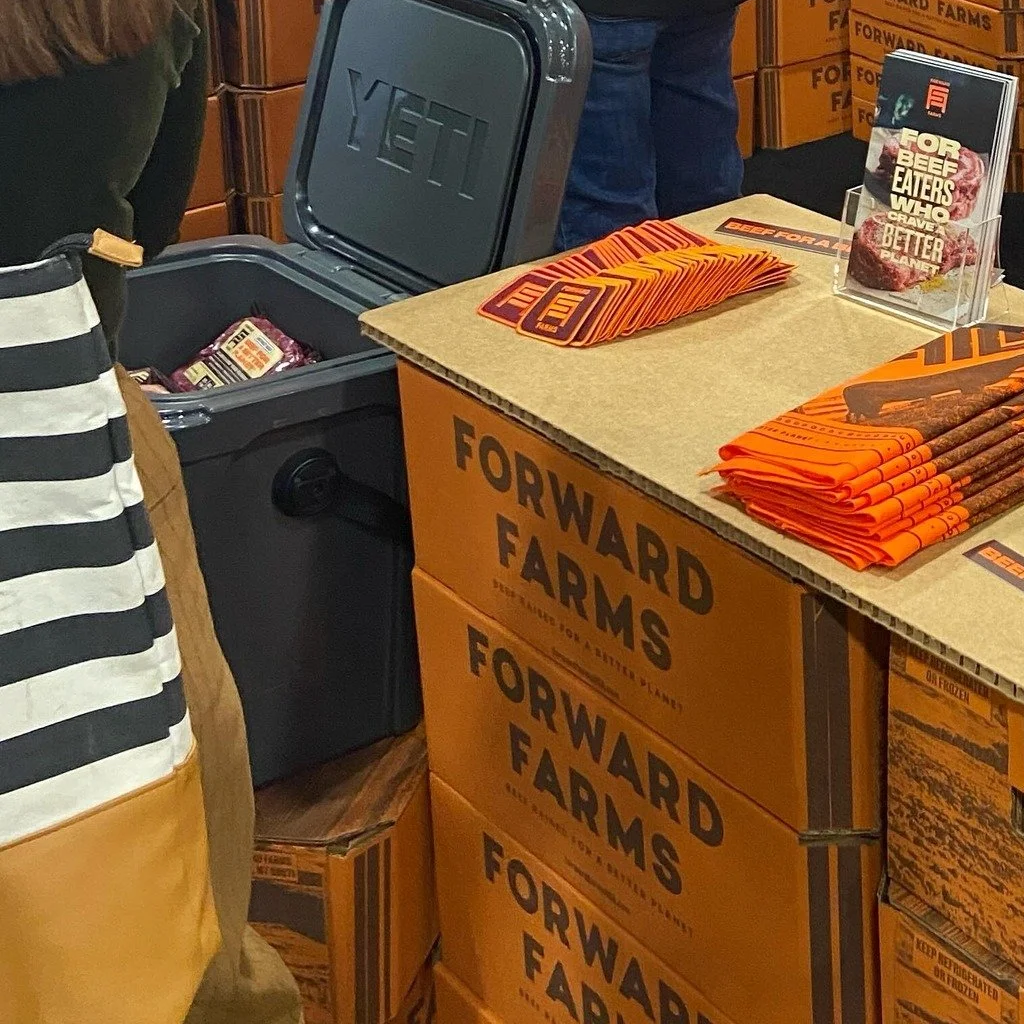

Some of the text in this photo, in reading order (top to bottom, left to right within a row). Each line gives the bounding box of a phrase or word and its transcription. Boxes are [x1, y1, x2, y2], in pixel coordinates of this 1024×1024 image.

[937, 0, 992, 31] FARMS
[347, 68, 490, 201] YETI
[900, 127, 963, 160] FOR
[896, 148, 958, 177] BEEF
[892, 165, 955, 207] EATERS
[887, 211, 947, 237] CRAVE A
[889, 193, 950, 223] WHO
[725, 221, 777, 236] BEEF
[774, 231, 817, 245] FOR
[816, 239, 830, 248] A
[882, 226, 945, 264] BETTER
[880, 249, 941, 275] PLANET
[452, 413, 714, 617] FORWARD
[496, 512, 671, 671] FARMS
[938, 677, 970, 705] FROZEN
[467, 624, 724, 847] FORWARD
[509, 721, 682, 895] FARMS
[483, 831, 714, 1024] FORWAR
[916, 936, 999, 1002] KEEP REFRIGERATED
[933, 965, 979, 1004] OR FROZEN
